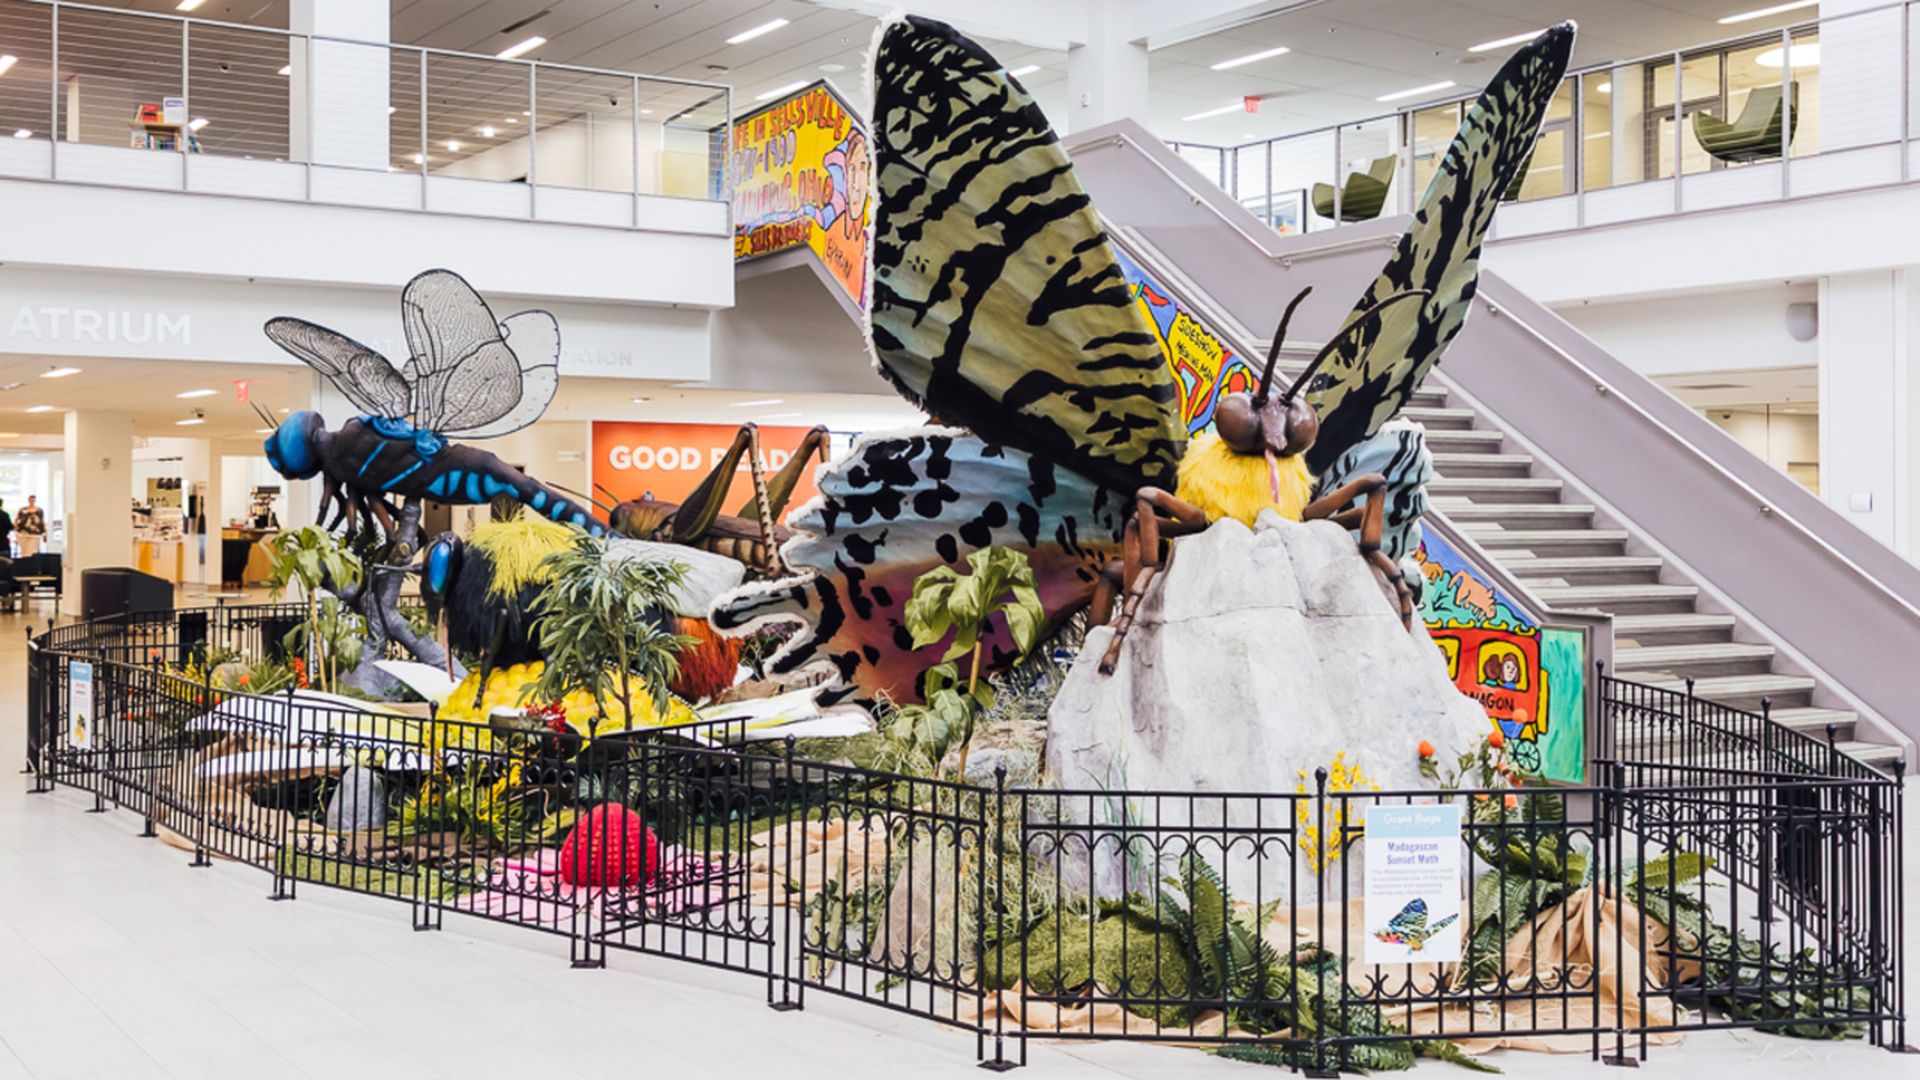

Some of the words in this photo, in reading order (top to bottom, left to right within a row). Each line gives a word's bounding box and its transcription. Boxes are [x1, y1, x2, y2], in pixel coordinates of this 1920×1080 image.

[769, 91, 845, 141] SELLSVILLE
[7, 305, 192, 345] ATRIUM
[609, 446, 702, 470] GOOD
[710, 447, 798, 472] READ
[1386, 855, 1415, 864] Sunset
[1418, 855, 1439, 864] Moth
